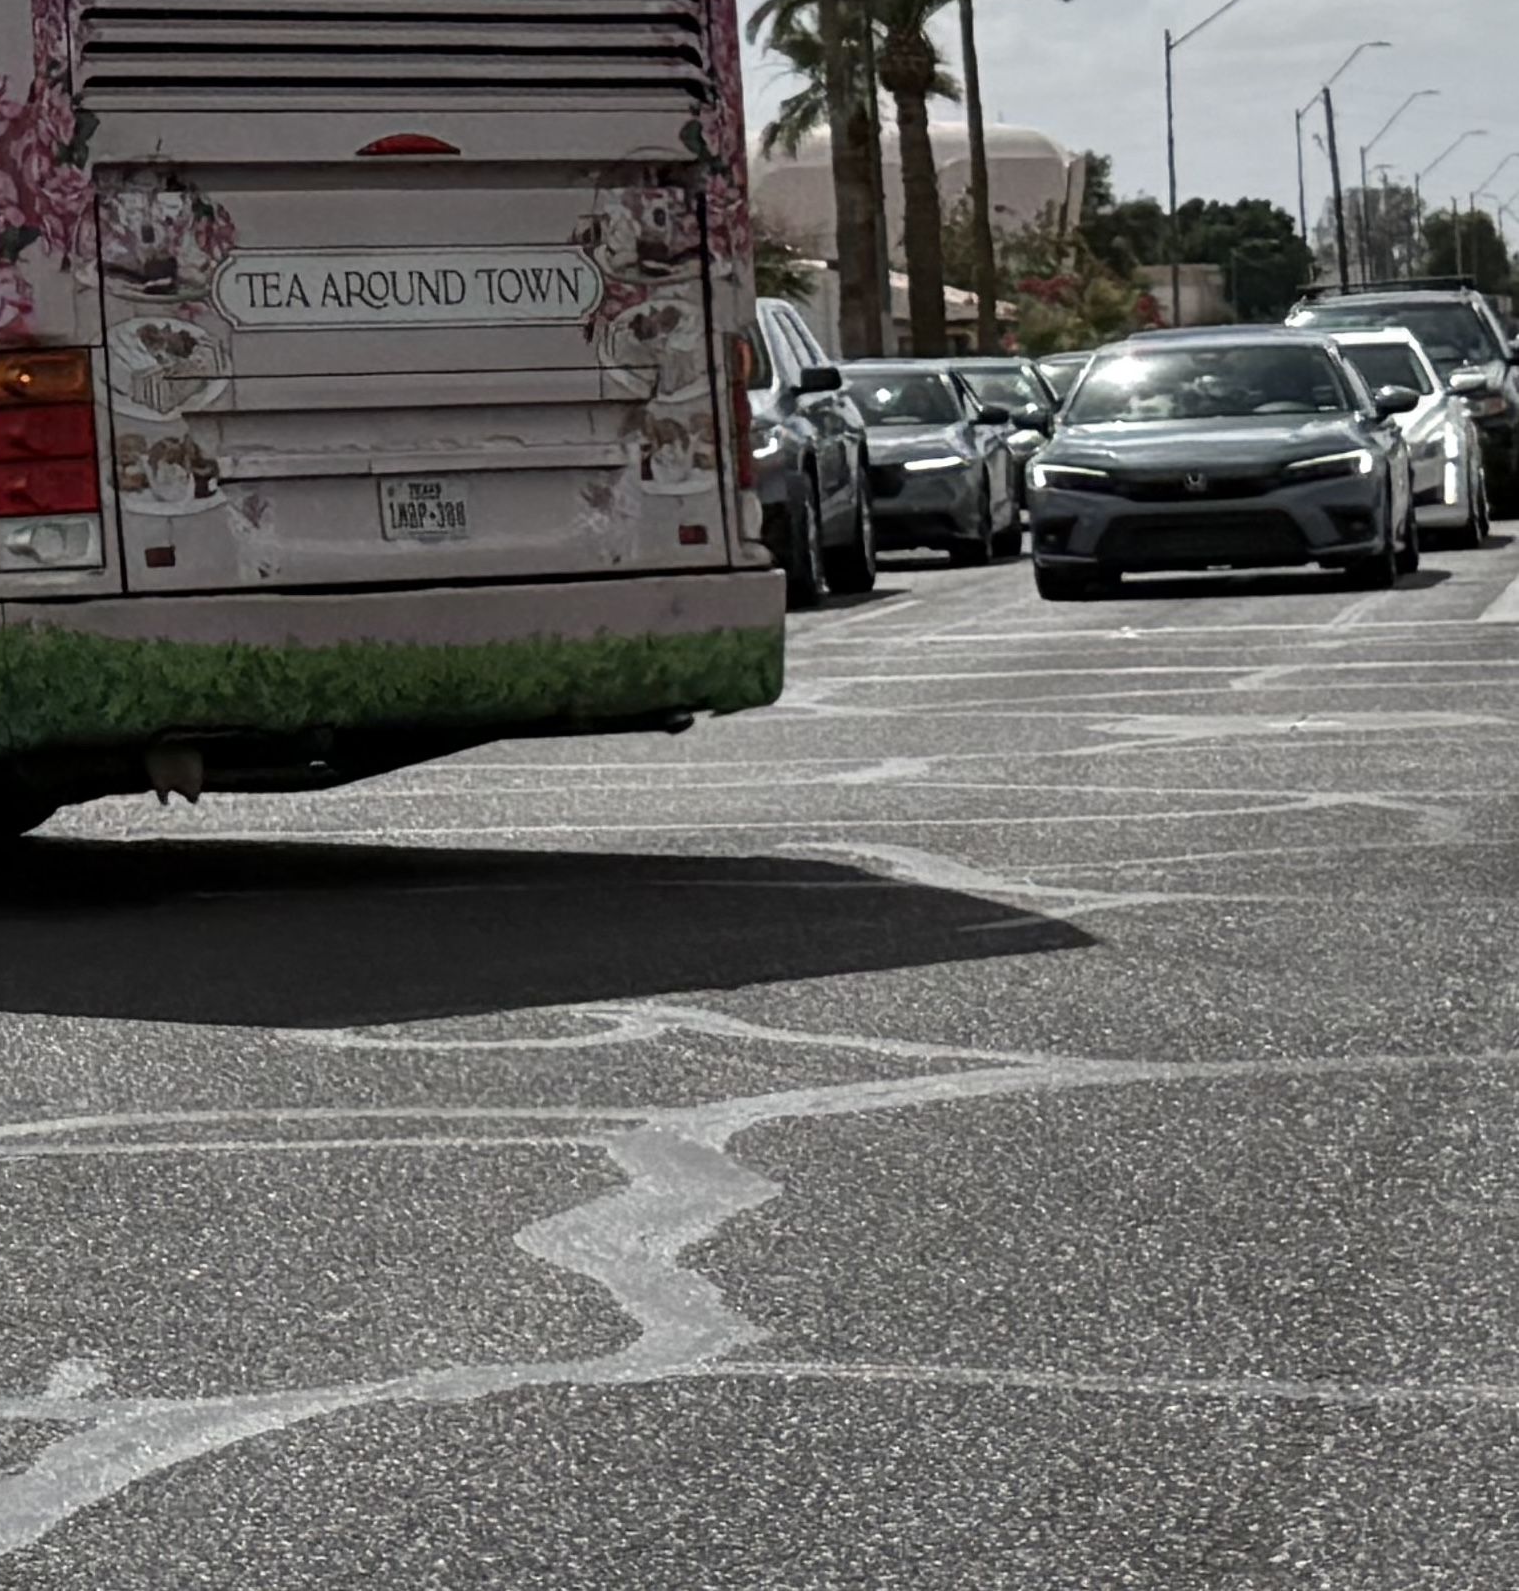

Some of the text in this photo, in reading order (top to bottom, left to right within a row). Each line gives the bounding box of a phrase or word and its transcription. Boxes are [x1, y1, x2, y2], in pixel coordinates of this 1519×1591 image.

[234, 267, 584, 310] TEA AROUND TOWN
